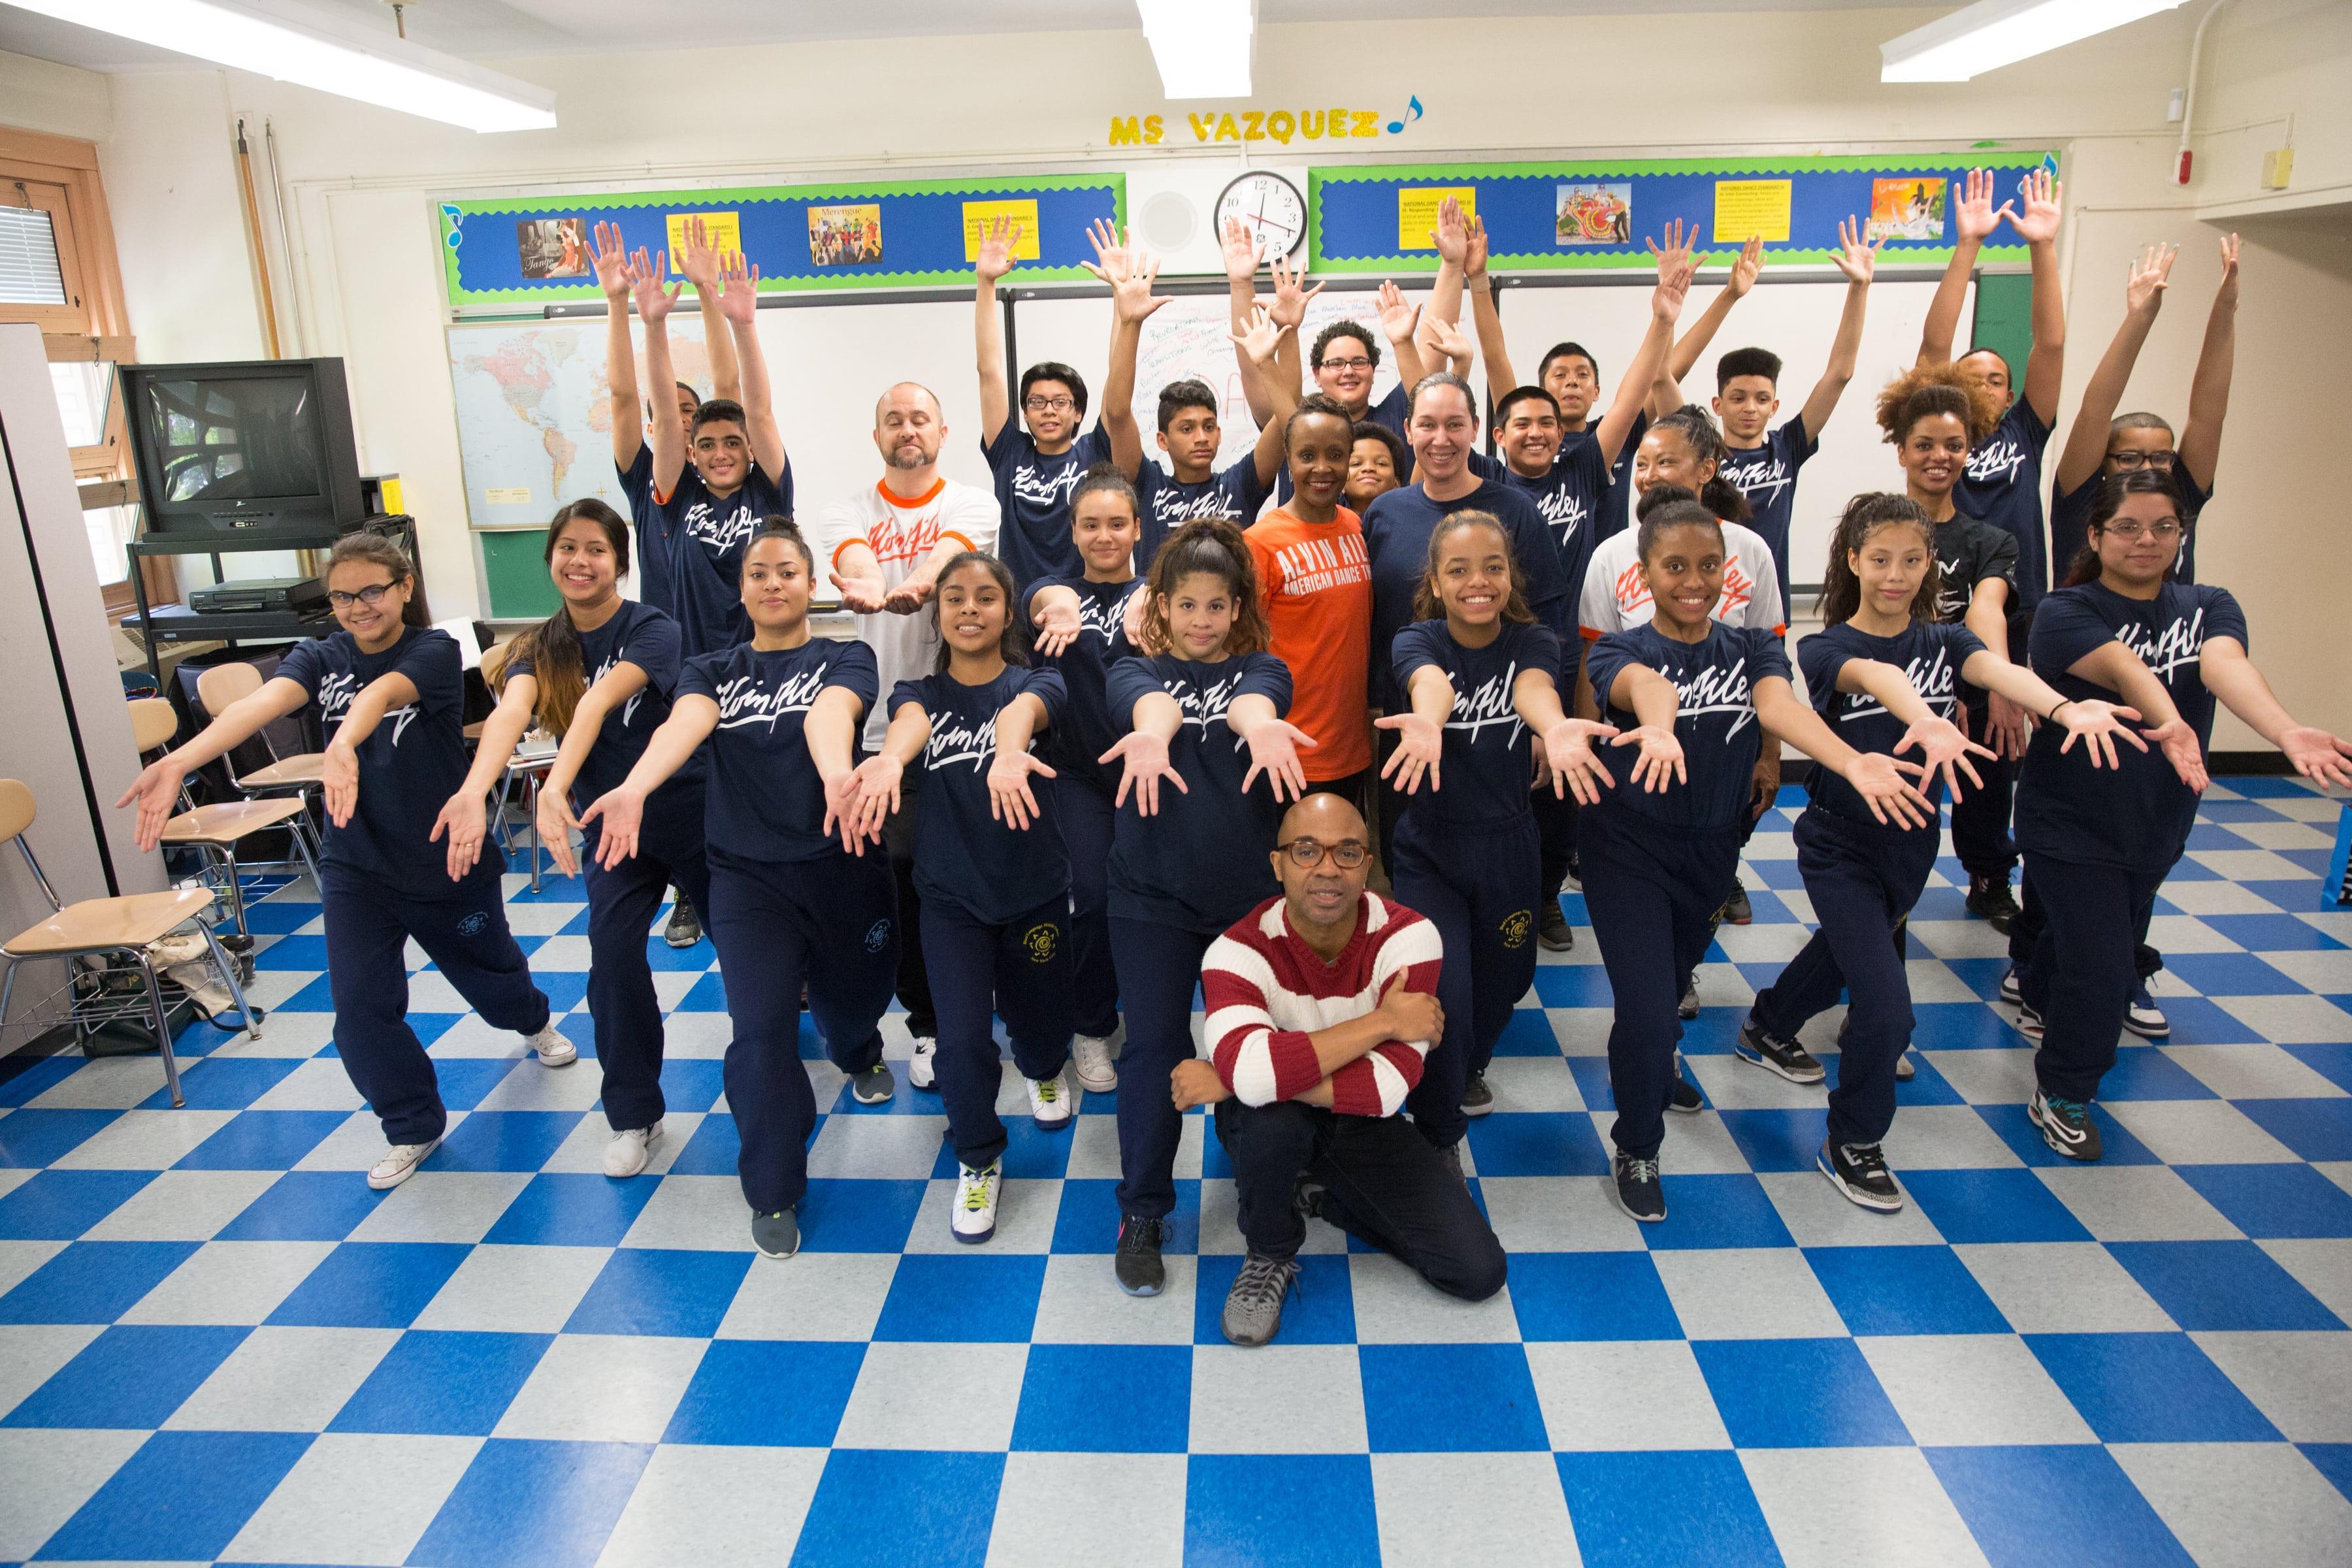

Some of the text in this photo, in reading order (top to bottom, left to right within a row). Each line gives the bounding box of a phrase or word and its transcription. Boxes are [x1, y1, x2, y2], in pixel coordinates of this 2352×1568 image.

[1109, 108, 1380, 144] MS VAZQUEZ
[1254, 180, 1267, 190] 12
[1228, 198, 1239, 207] 10
[1284, 197, 1292, 207] 2
[1288, 212, 1296, 223] 3
[1274, 242, 1282, 252] 5
[525, 255, 554, 272] Tango
[1276, 538, 1338, 582] ALVIN
[1284, 571, 1333, 596] AMERICAN
[1333, 566, 1362, 586] DANCE
